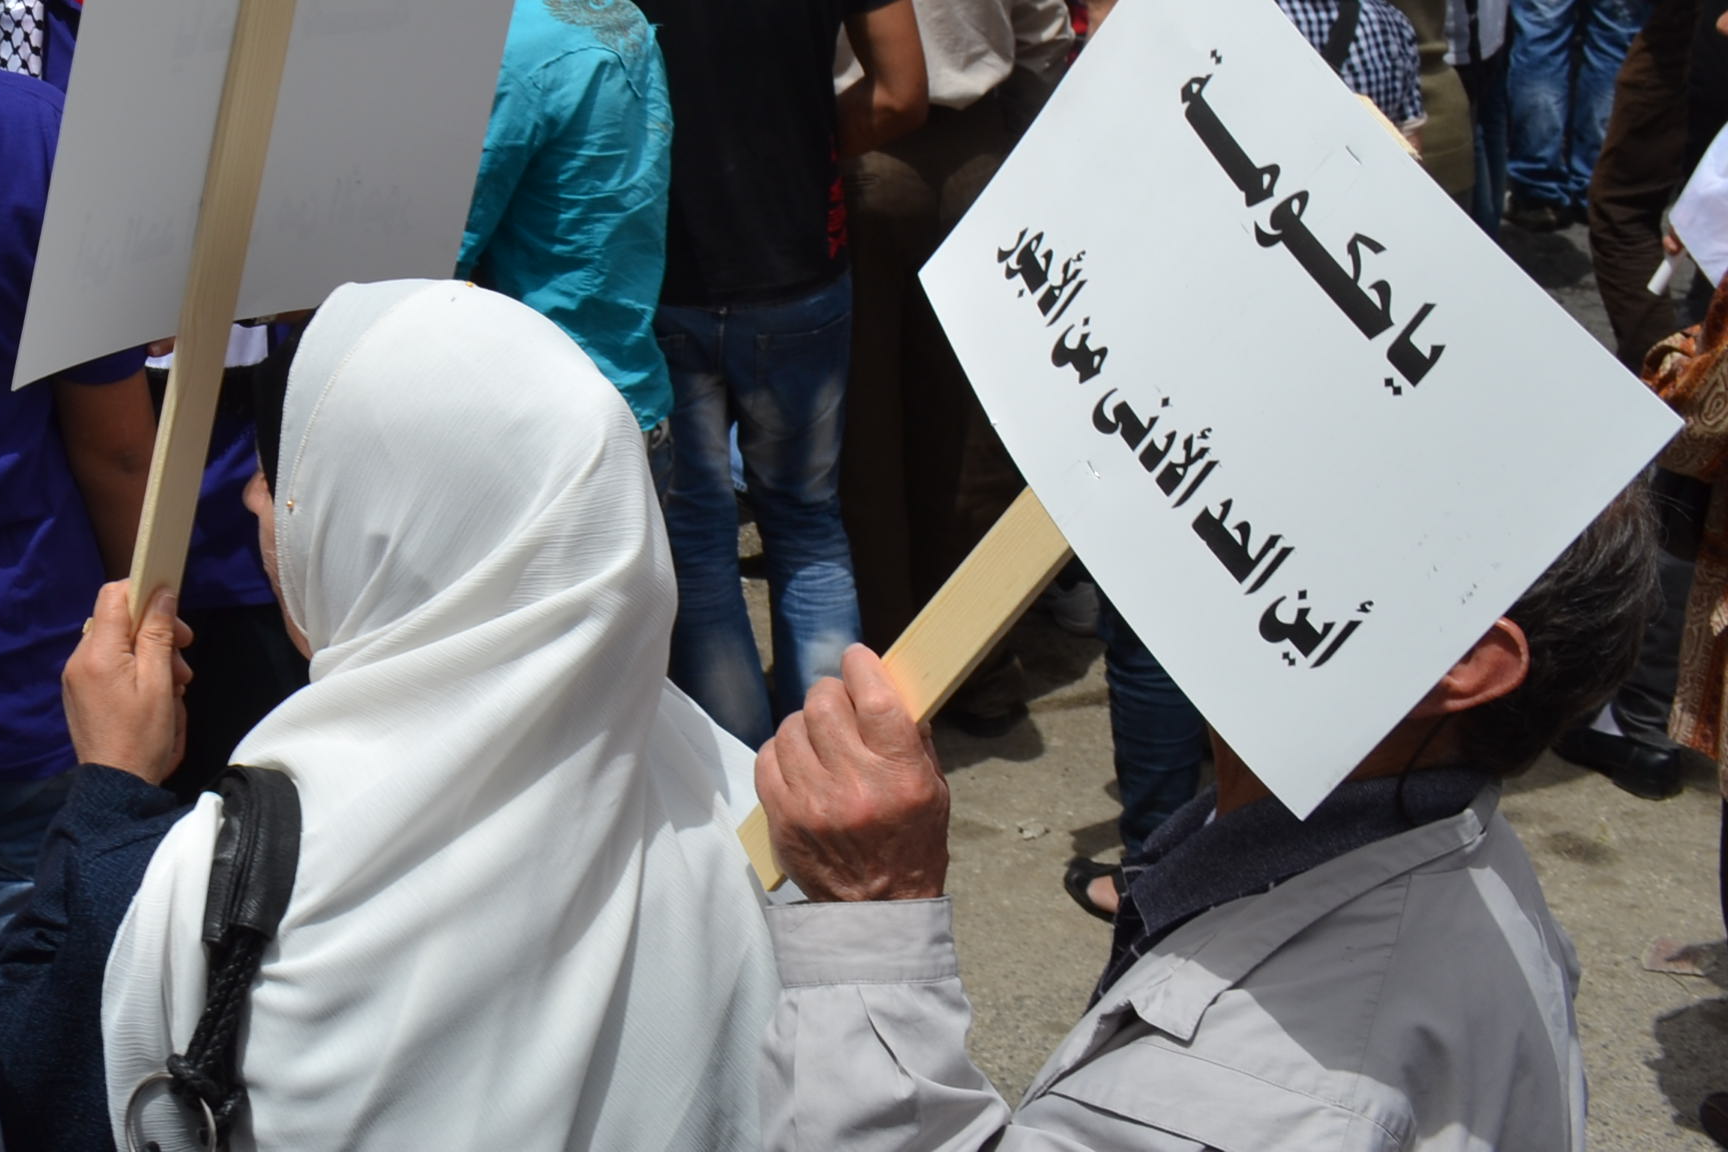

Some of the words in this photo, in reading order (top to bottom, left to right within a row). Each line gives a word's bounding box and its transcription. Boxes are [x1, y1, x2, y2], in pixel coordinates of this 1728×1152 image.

[1180, 48, 1394, 340] حكومة
[997, 227, 1088, 328] الأجور
[1051, 315, 1109, 385] من
[1092, 387, 1220, 509] الأدنى
[1192, 498, 1296, 596] الحد
[1259, 589, 1374, 669] أين
